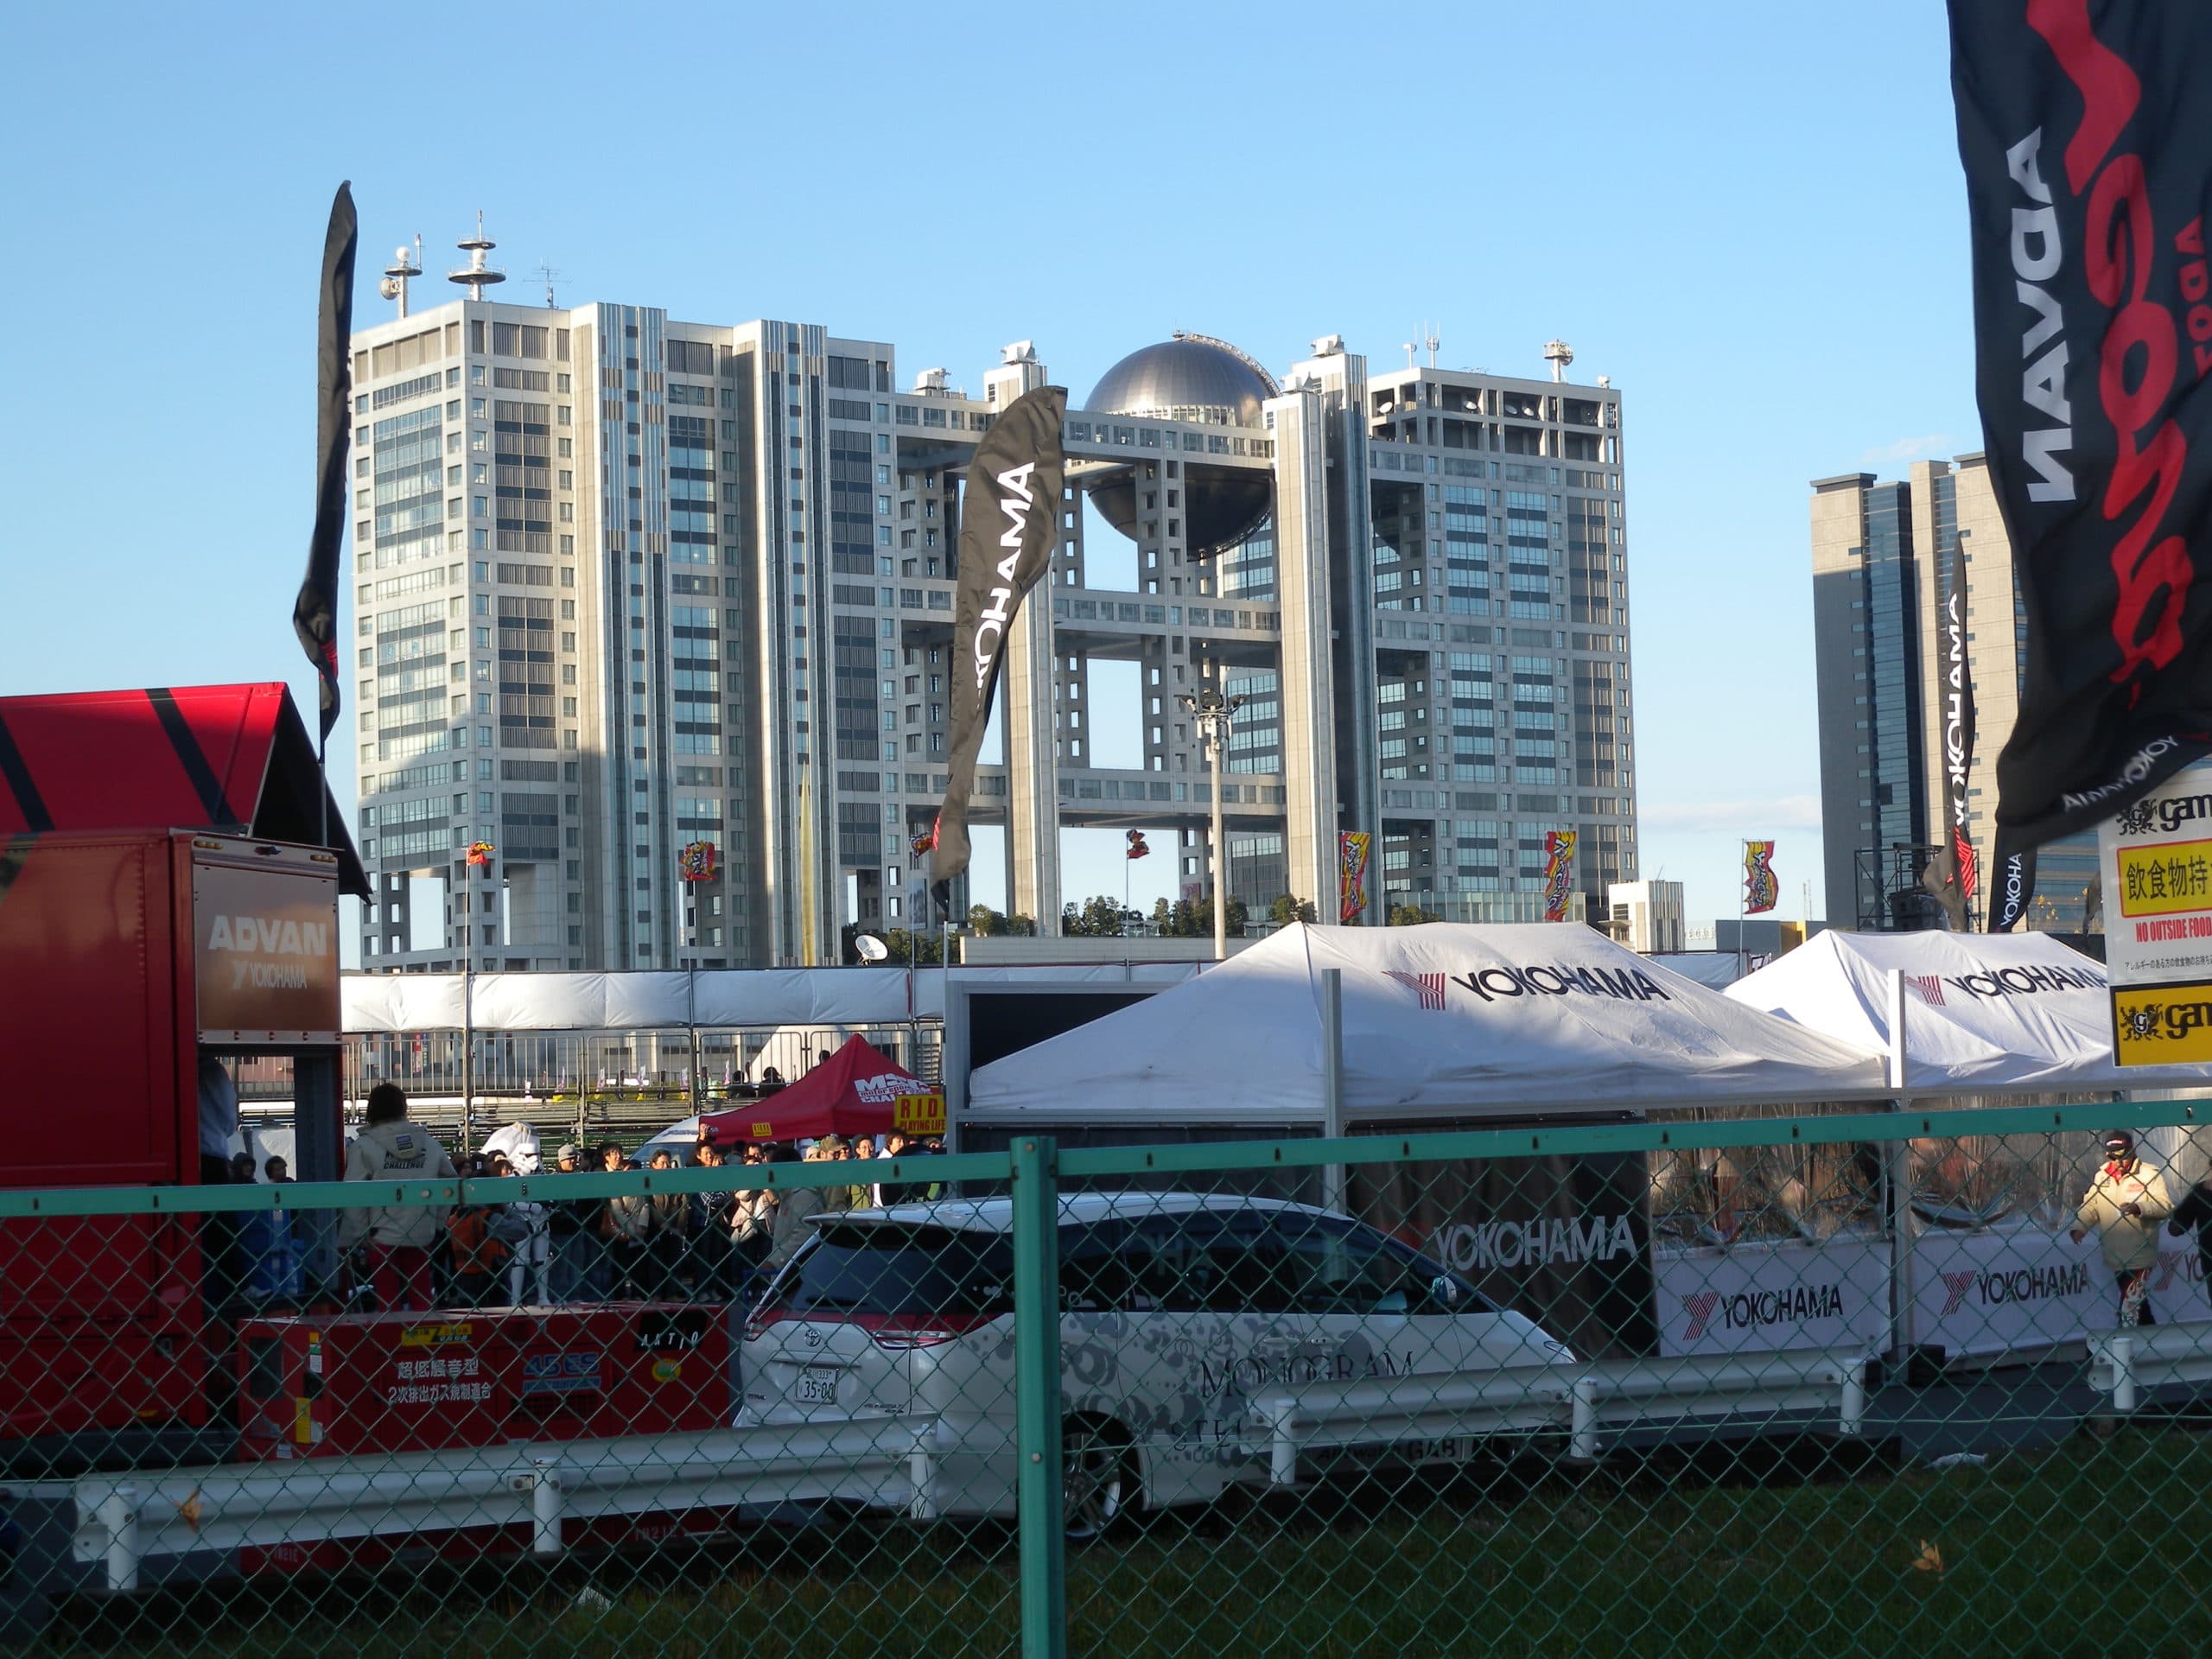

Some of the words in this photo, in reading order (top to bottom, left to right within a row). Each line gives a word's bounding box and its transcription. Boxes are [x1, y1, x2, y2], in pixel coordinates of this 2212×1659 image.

[207, 914, 327, 956] ADVAN
[2135, 921, 2148, 943] NO
[2150, 918, 2187, 942] OUTSIDE
[250, 963, 308, 988] YOKOHAMA
[1451, 965, 1671, 1002] YOKOHAMA
[1943, 965, 2108, 1001] YOKOHAMA
[1433, 1214, 1639, 1271] YOKOHAMA
[1977, 1262, 2091, 1305] YOKOHAMA
[1720, 1284, 1843, 1329] YOKOHAMA
[398, 1357, 480, 1380] 超低騒音型
